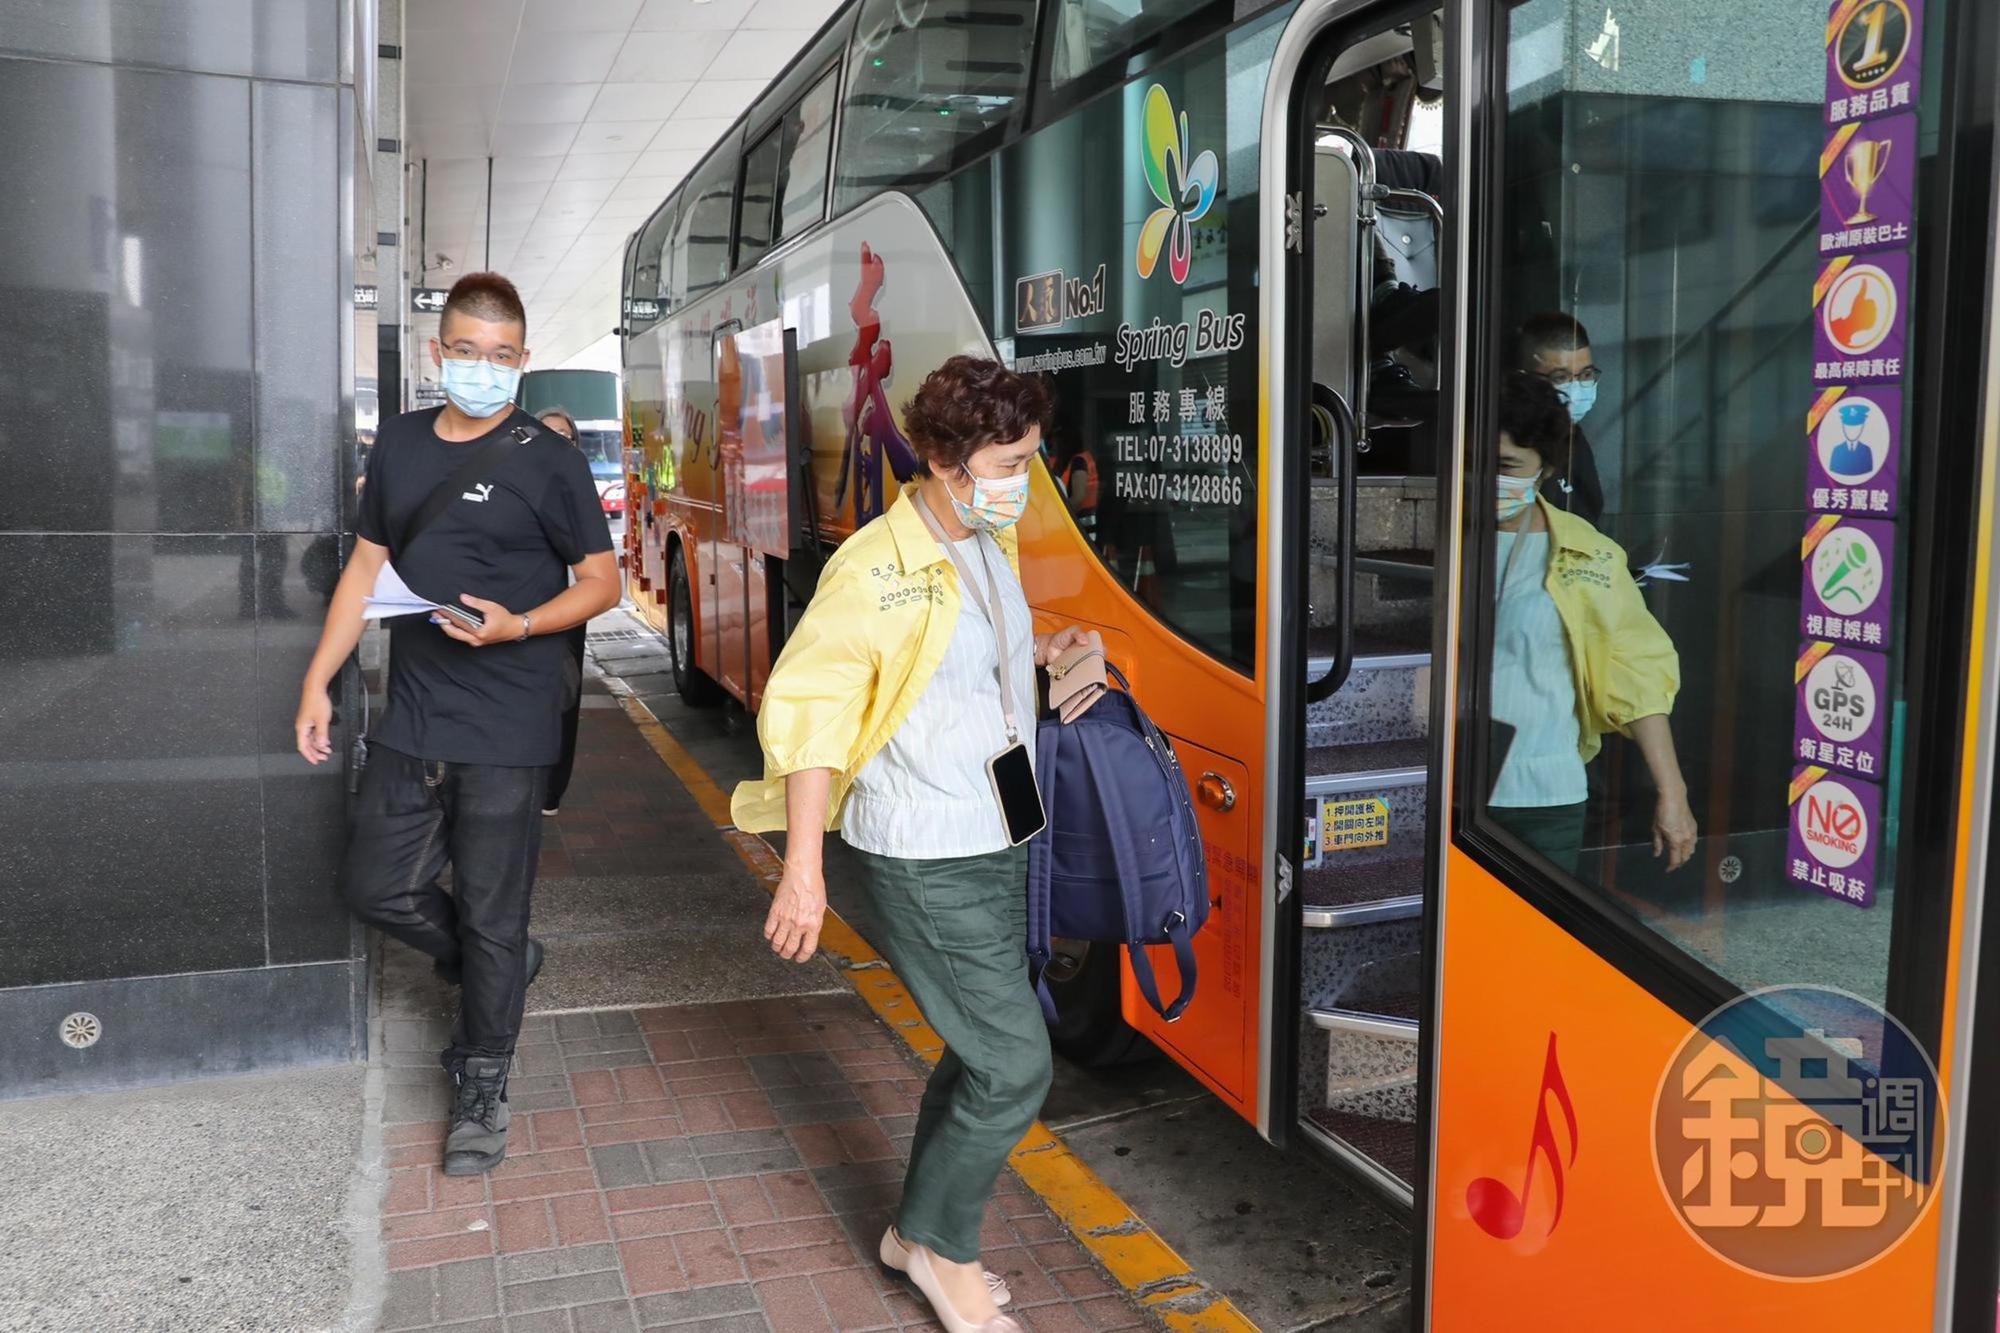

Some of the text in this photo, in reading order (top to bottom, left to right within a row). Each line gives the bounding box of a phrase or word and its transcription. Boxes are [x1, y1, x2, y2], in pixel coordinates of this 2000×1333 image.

[1829, 81, 1910, 123] 服務品質
[1819, 222, 1908, 251] 歐洲原裝巴士
[1064, 263, 1106, 320] No.1
[1114, 308, 1245, 373] Spring Bus
[1814, 358, 1901, 379] 最高保障責任
[1128, 385, 1227, 424] 服務專線
[1115, 434, 1243, 464] TEL:07-3138899
[1115, 472, 1242, 505] FAX:07-3128866
[1812, 488, 1889, 512] 優秀駕駛
[1806, 614, 1882, 644] 視聽娛樂
[1814, 687, 1865, 717] GPS
[1823, 713, 1853, 732] 24H
[1800, 738, 1875, 774] 衛星定位
[1806, 829, 1859, 855] SMOKING
[1792, 859, 1866, 901] 禁止吸菸
